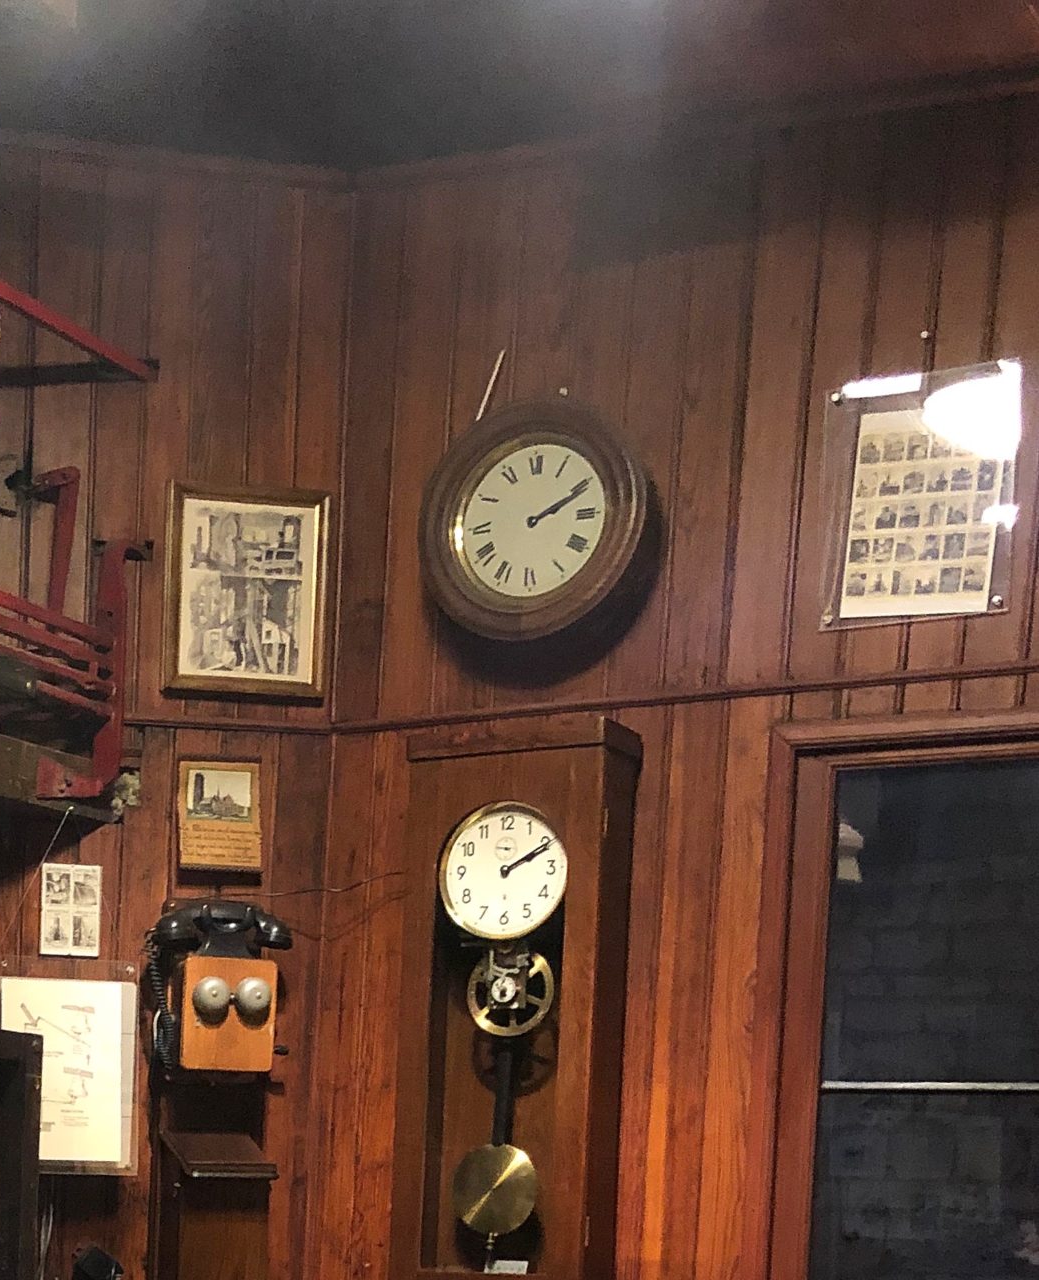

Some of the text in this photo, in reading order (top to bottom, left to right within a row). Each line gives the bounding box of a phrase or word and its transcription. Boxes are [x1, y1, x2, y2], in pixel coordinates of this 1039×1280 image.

[500, 815, 515, 830] 12
[527, 820, 533, 835] 1
[478, 824, 489, 839] 11
[461, 841, 475, 857] 10
[457, 865, 467, 880] 9
[546, 859, 556, 875] 3
[462, 888, 472, 904] 8
[538, 884, 549, 899] 4
[479, 905, 489, 920] 7
[499, 911, 509, 925] 6
[522, 903, 532, 919] 5
